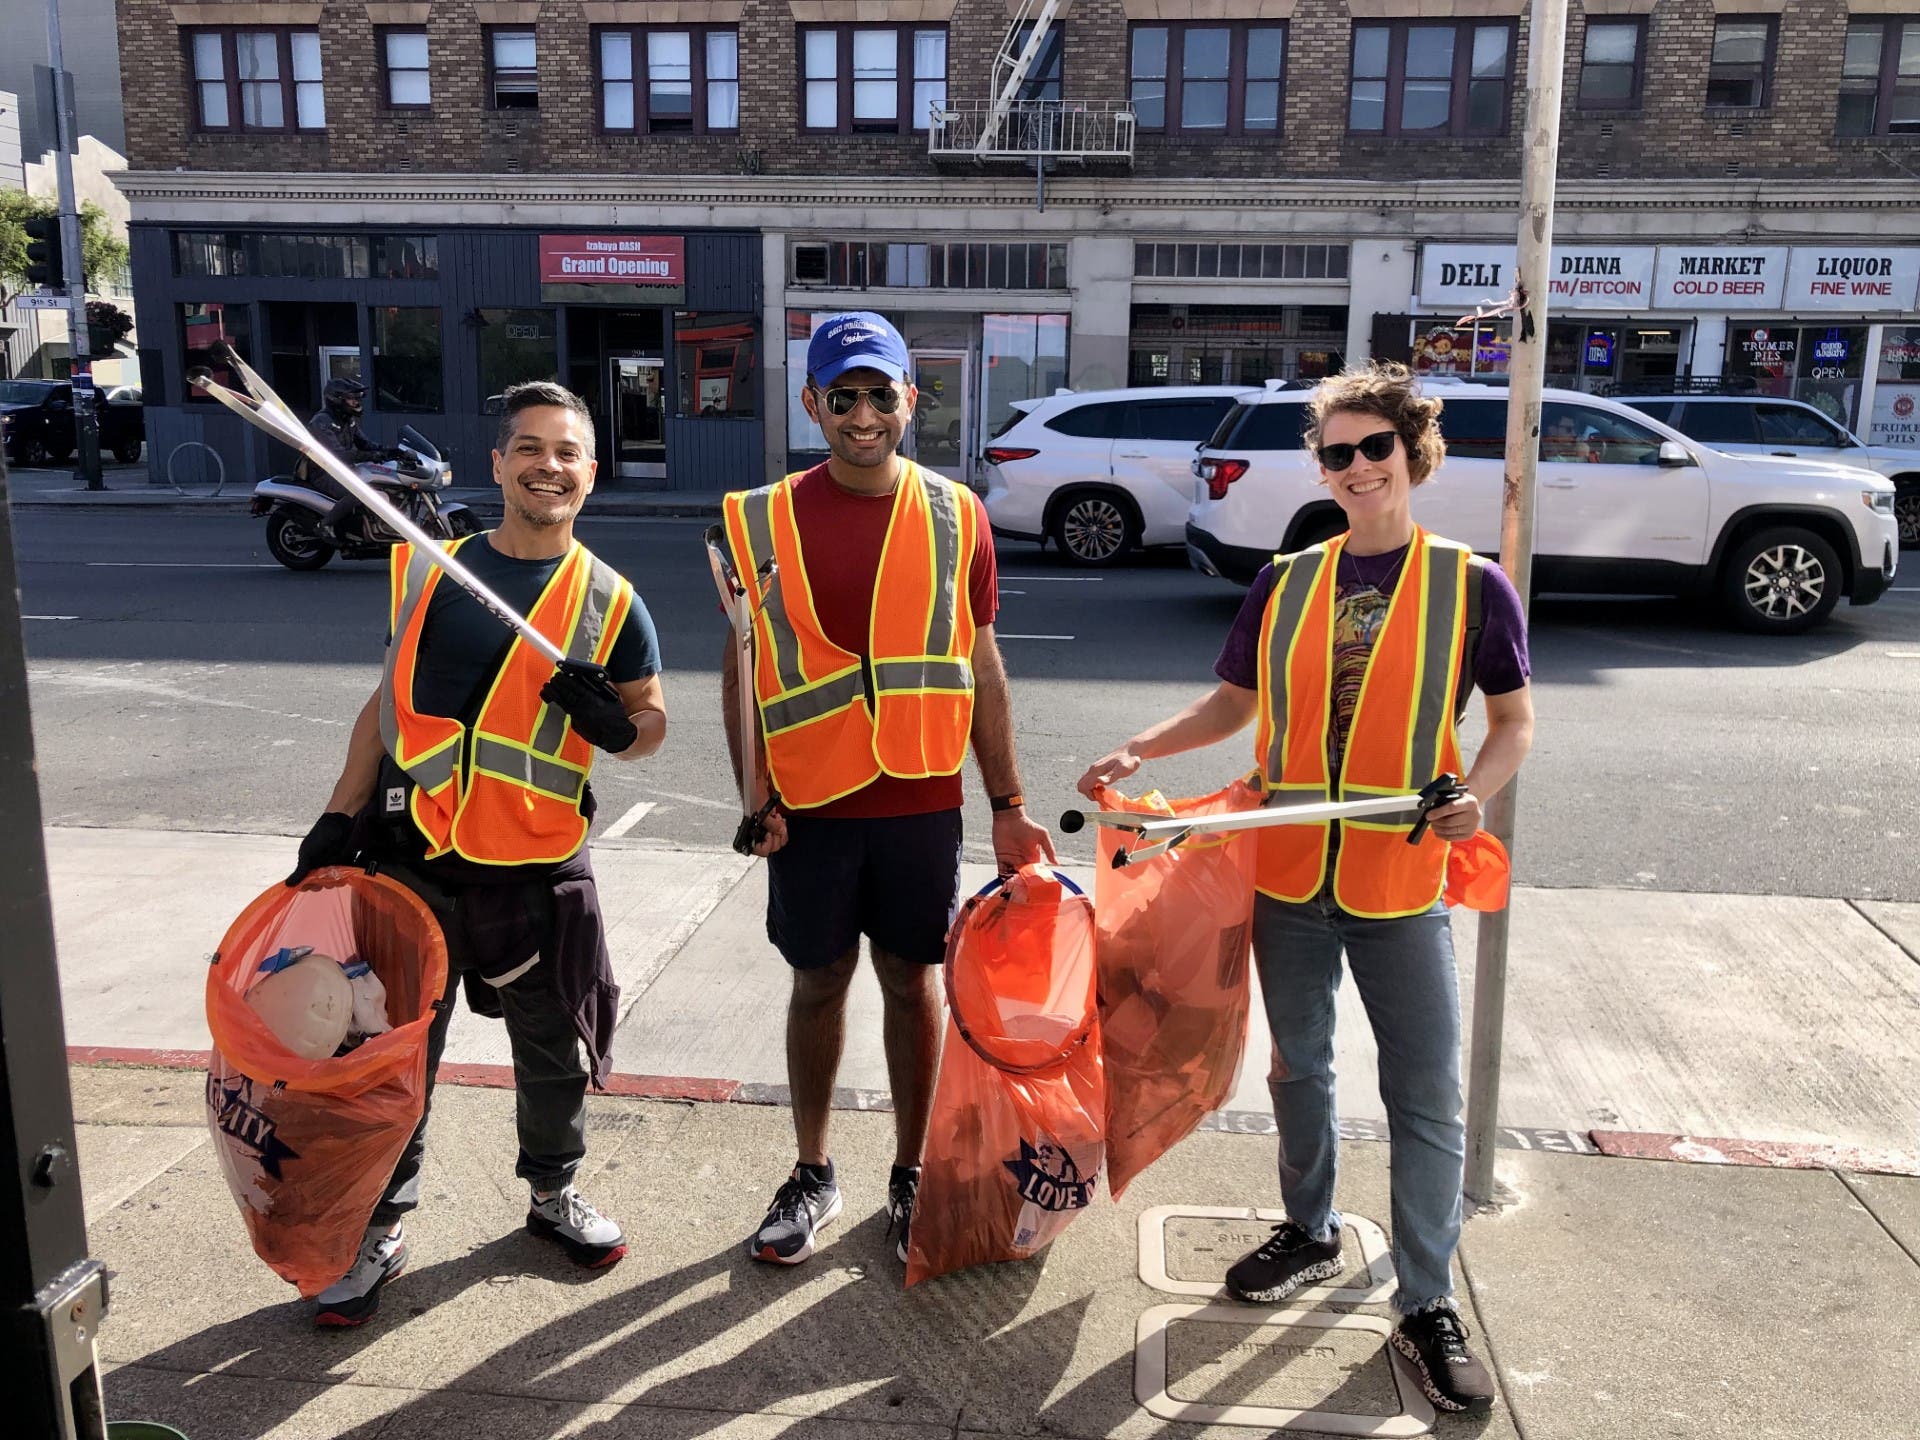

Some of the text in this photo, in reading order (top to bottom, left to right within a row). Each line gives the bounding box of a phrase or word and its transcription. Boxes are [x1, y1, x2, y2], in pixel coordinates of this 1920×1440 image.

[586, 241, 641, 252] Izakaya DASH
[562, 256, 669, 276] Grand Opening
[1560, 257, 1621, 274] DIANA
[1679, 257, 1765, 275] MARKET
[1816, 258, 1892, 279] LIQUOR
[1440, 264, 1501, 286] DELI
[1549, 278, 1641, 296] TM/BITCOIN
[1673, 281, 1765, 294] COLD BEER
[1811, 282, 1892, 295] FINE WINE
[48, 299, 57, 307] St
[1742, 341, 1794, 351] TRUMER
[1754, 351, 1781, 361] PILS
[1811, 367, 1844, 379] OPEN
[1886, 433, 1916, 444] PILS
[1023, 1172, 1078, 1210] LOVE
[1218, 1233, 1272, 1244] SHEL
